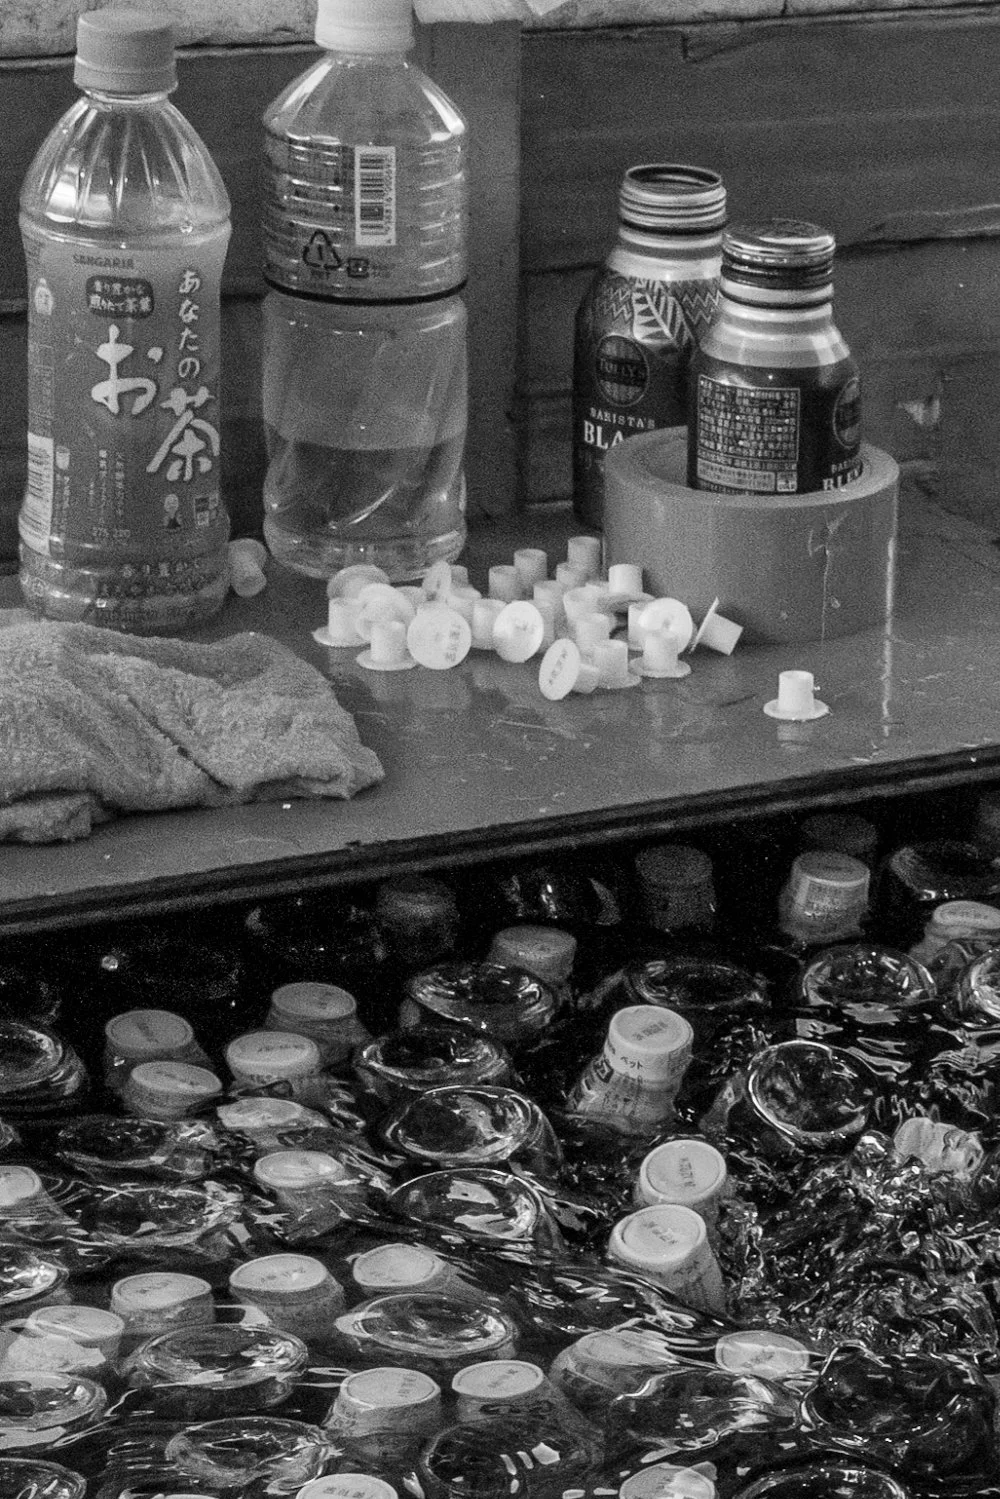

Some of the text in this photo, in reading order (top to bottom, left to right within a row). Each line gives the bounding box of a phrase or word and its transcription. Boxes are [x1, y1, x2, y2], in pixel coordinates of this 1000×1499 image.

[178, 270, 200, 379] あなたの
[589, 406, 656, 430] BARISTA'S
[584, 420, 624, 450] BLA
